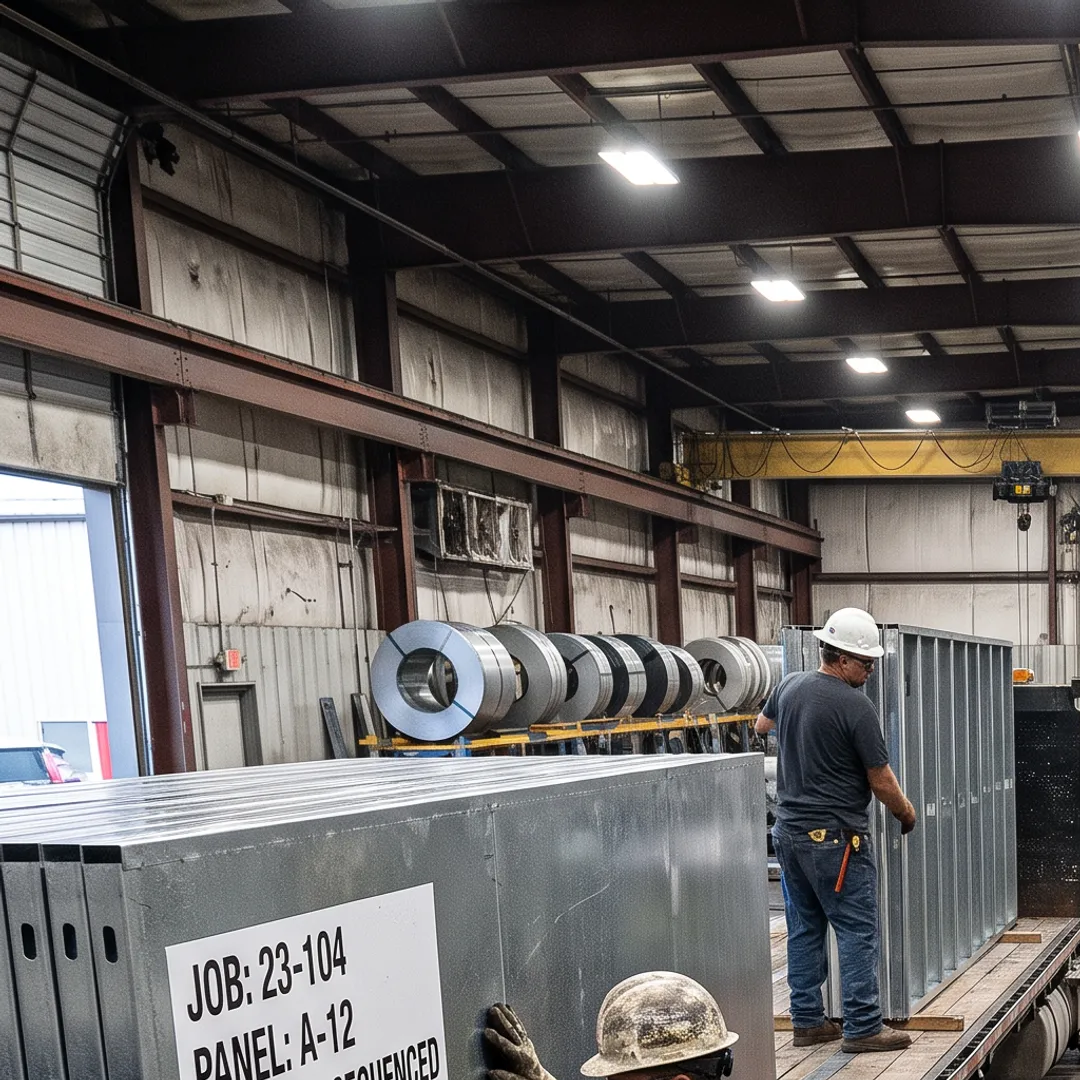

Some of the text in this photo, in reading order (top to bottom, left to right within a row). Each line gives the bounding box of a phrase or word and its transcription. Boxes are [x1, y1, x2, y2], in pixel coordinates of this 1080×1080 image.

[187, 926, 347, 1022] JOB: 23-104
[300, 998, 356, 1067] A-12
